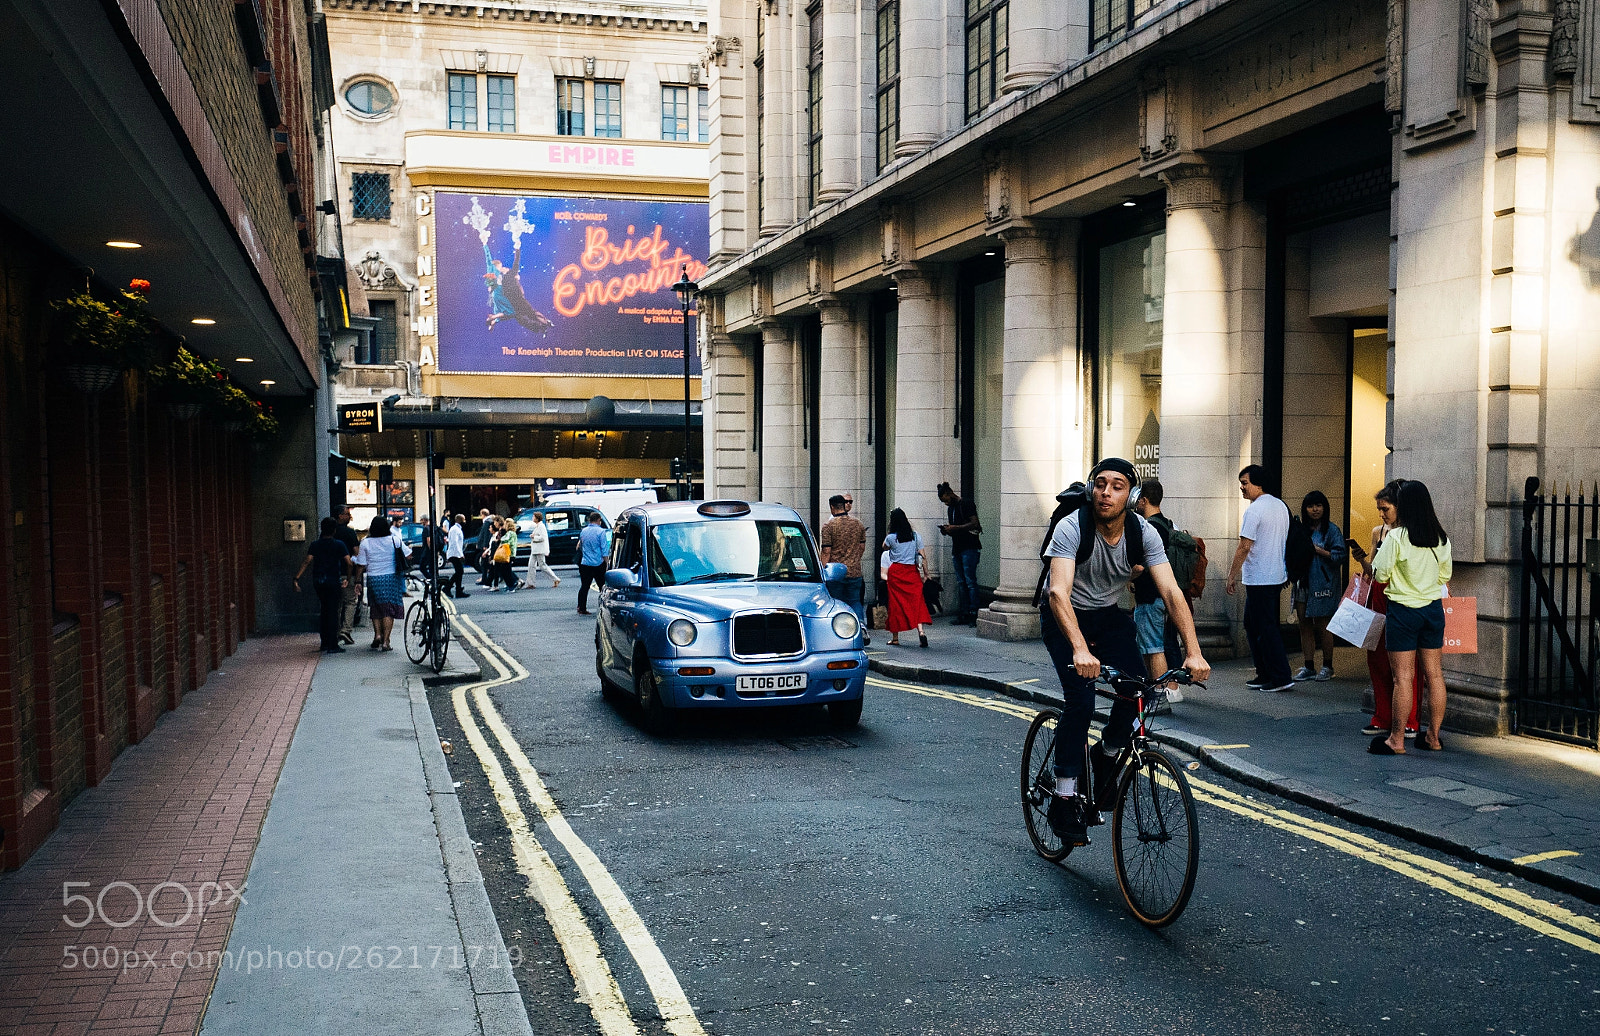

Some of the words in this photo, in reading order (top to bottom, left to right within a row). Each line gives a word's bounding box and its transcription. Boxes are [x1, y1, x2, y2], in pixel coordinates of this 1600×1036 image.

[548, 145, 635, 167] EMPIRE
[581, 224, 669, 271] Brief
[416, 195, 435, 366] CINEMA
[624, 307, 645, 315] musical
[646, 307, 672, 316] adapted
[643, 316, 652, 324] by
[502, 347, 516, 355] The
[518, 347, 553, 357] Kneehigh
[554, 347, 583, 356] Theatre
[585, 348, 625, 357] Production
[627, 349, 643, 357] LIVE
[645, 349, 658, 358] ON
[660, 350, 684, 358] STAGE
[345, 409, 374, 418] BYRON
[740, 677, 775, 689] LT06
[777, 675, 802, 688] OCR
